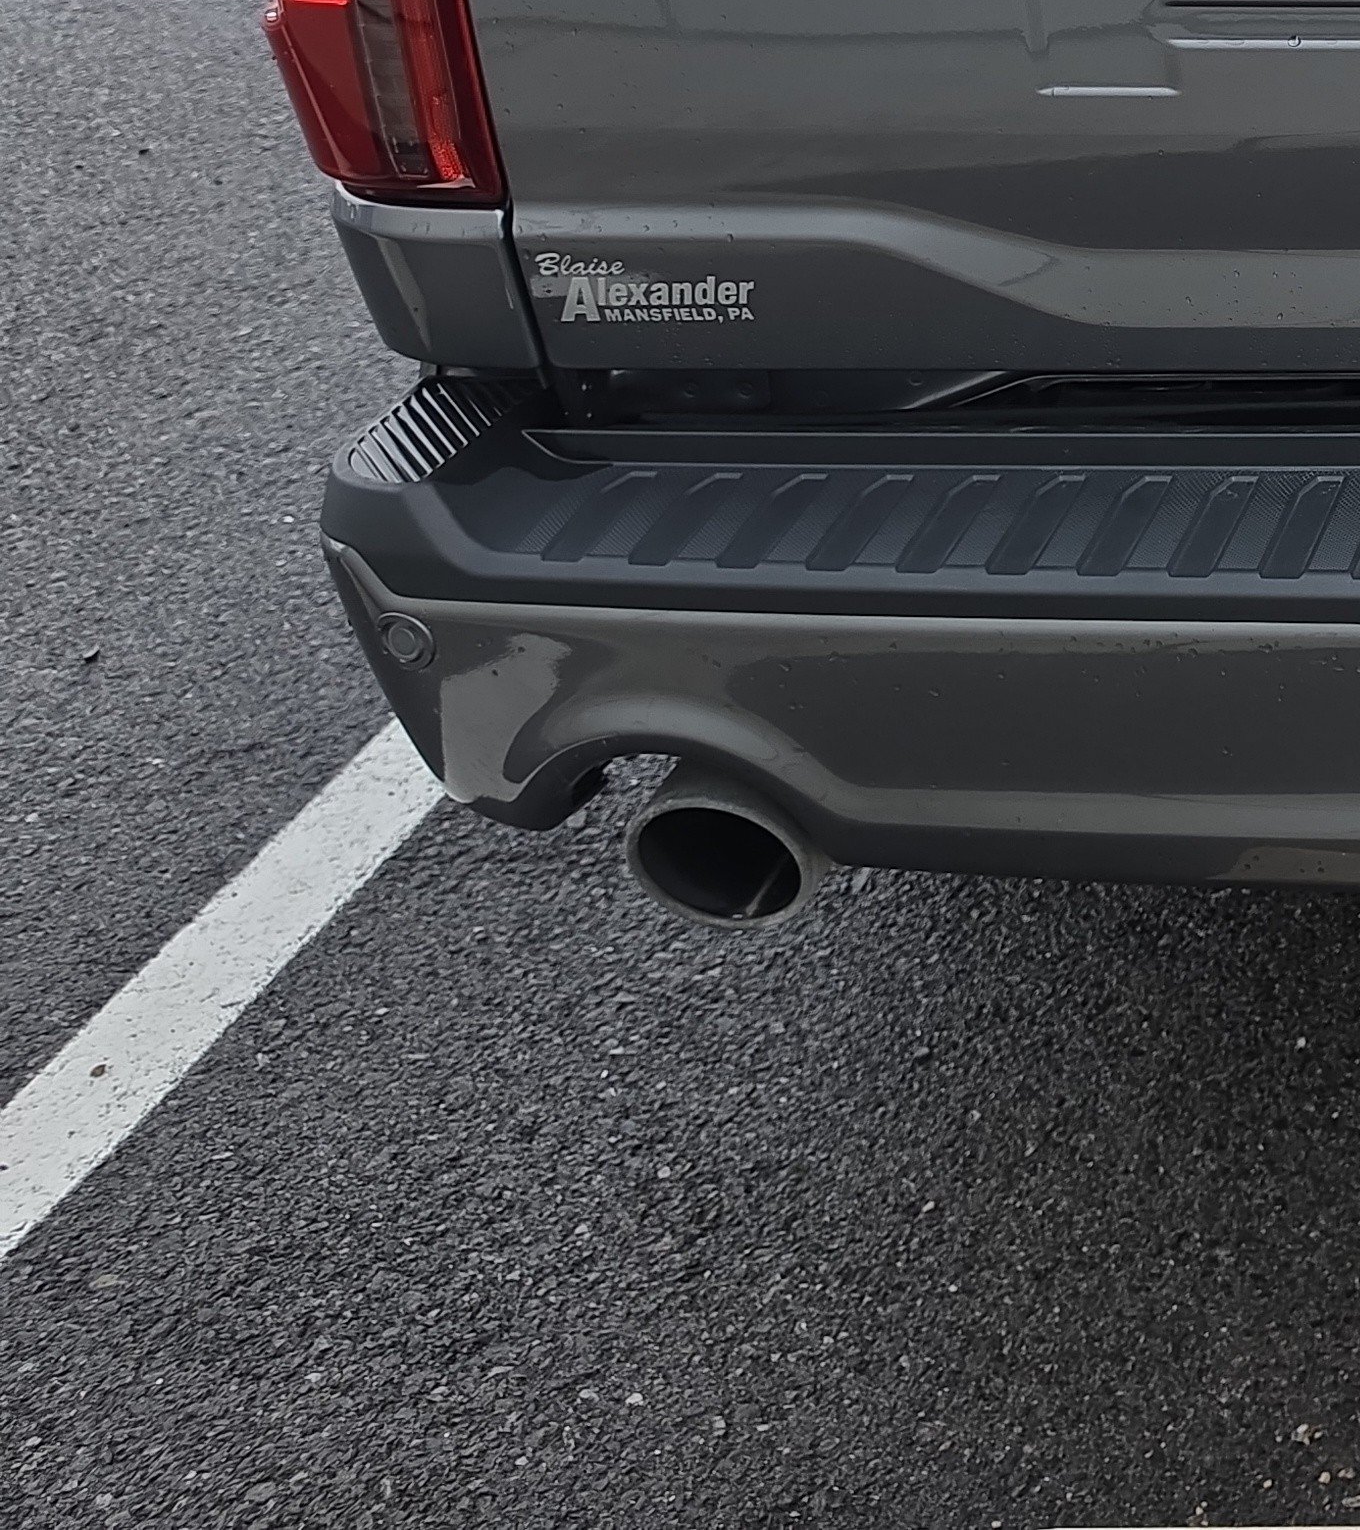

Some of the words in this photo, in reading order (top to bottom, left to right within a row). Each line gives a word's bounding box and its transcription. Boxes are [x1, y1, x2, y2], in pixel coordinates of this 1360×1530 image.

[534, 252, 625, 276] Blaise
[561, 275, 755, 322] Alexander
[604, 307, 724, 324] MANSFIELD,
[728, 307, 755, 321] PA
